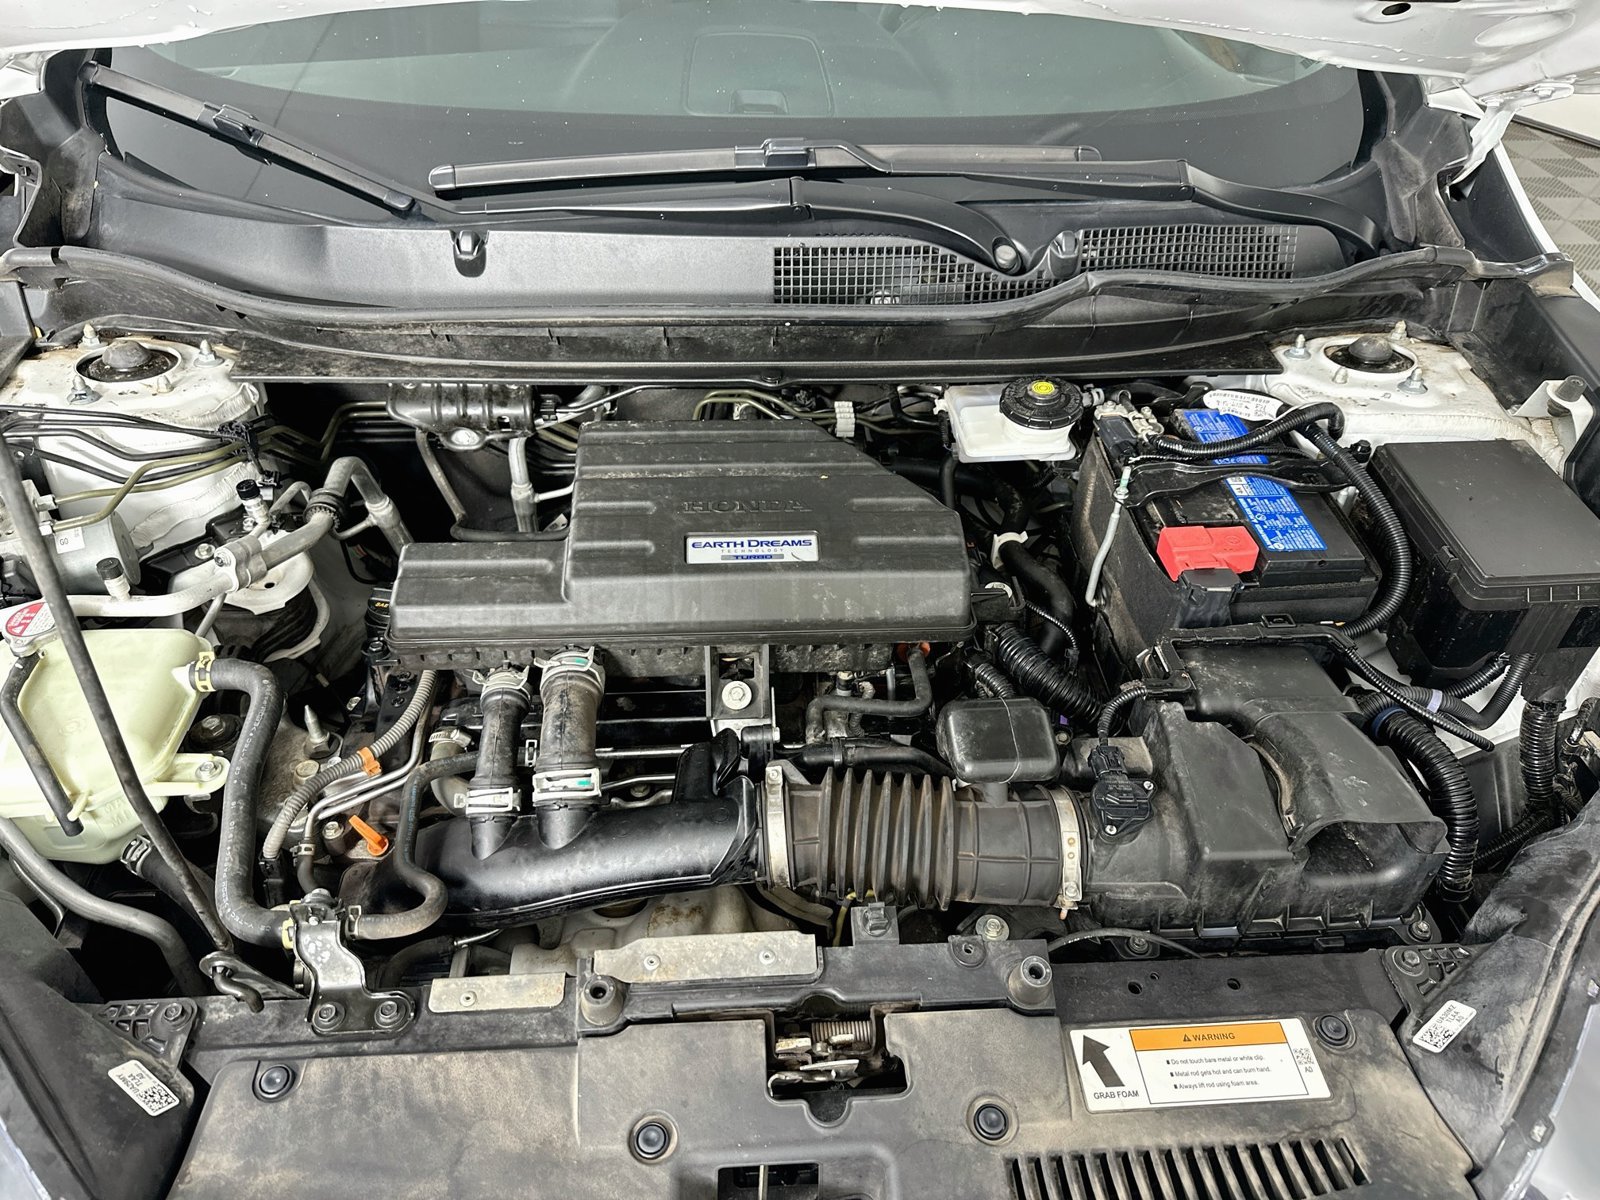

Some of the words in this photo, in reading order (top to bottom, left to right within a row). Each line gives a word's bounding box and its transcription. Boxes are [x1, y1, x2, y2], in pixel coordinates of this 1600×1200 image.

[683, 500, 812, 513] HONDA
[692, 541, 744, 549] EARTH
[747, 539, 813, 548] DREAMS
[1192, 1032, 1236, 1041] WARNING
[1093, 1091, 1116, 1100] GRAB
[1116, 1090, 1140, 1098] FOAM
